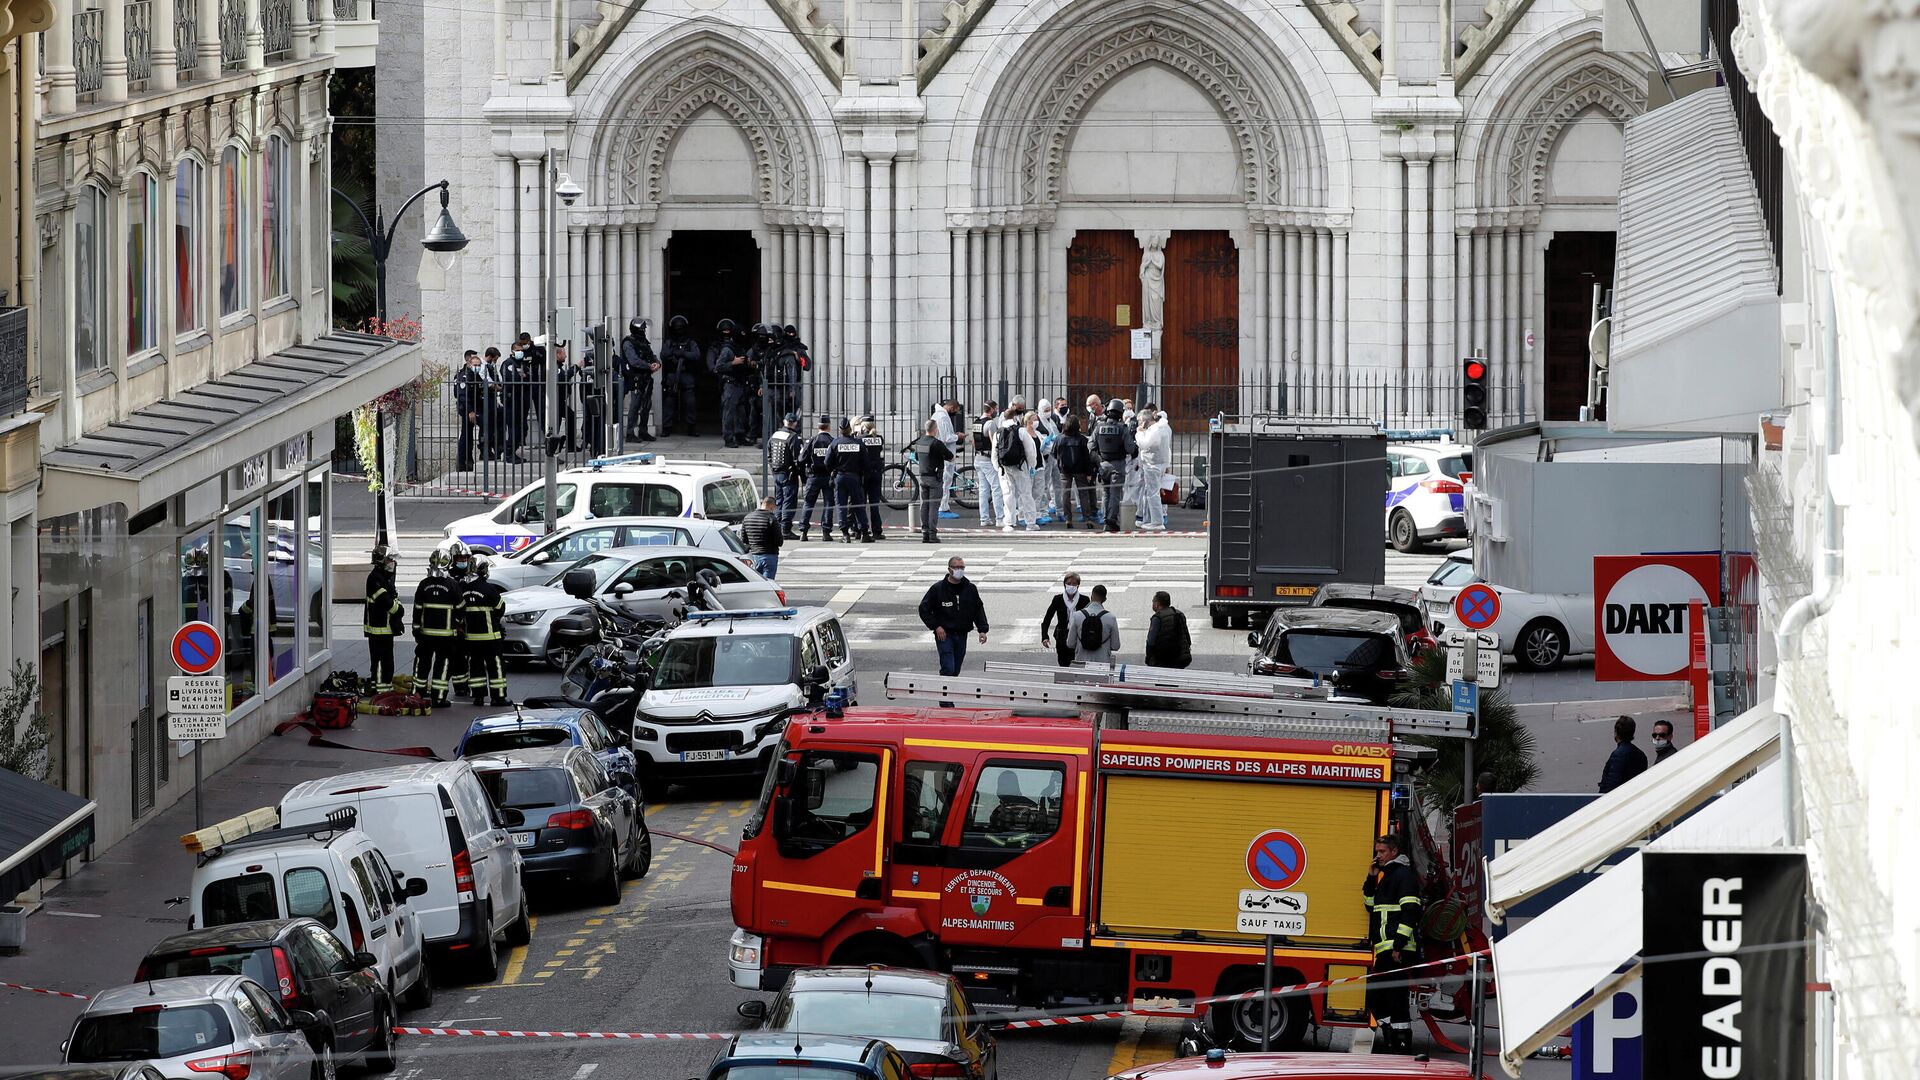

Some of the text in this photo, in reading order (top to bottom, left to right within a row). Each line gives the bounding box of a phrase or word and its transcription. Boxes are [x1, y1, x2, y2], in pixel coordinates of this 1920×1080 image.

[1606, 603, 1708, 634] DART
[1332, 745, 1389, 757] GIMAEX
[1102, 754, 1381, 779] SAPEURS POMPIERS DES ALPES MARITIMES
[945, 871, 969, 893] SERVICE
[967, 880, 996, 888] D'INCENDIE
[960, 886, 967, 894] ET
[977, 887, 1002, 896] SECOURS
[942, 917, 1015, 931] ALPES-MARITIMES
[1241, 918, 1302, 930] SAUF TAXIS
[1593, 973, 1643, 1074] P
